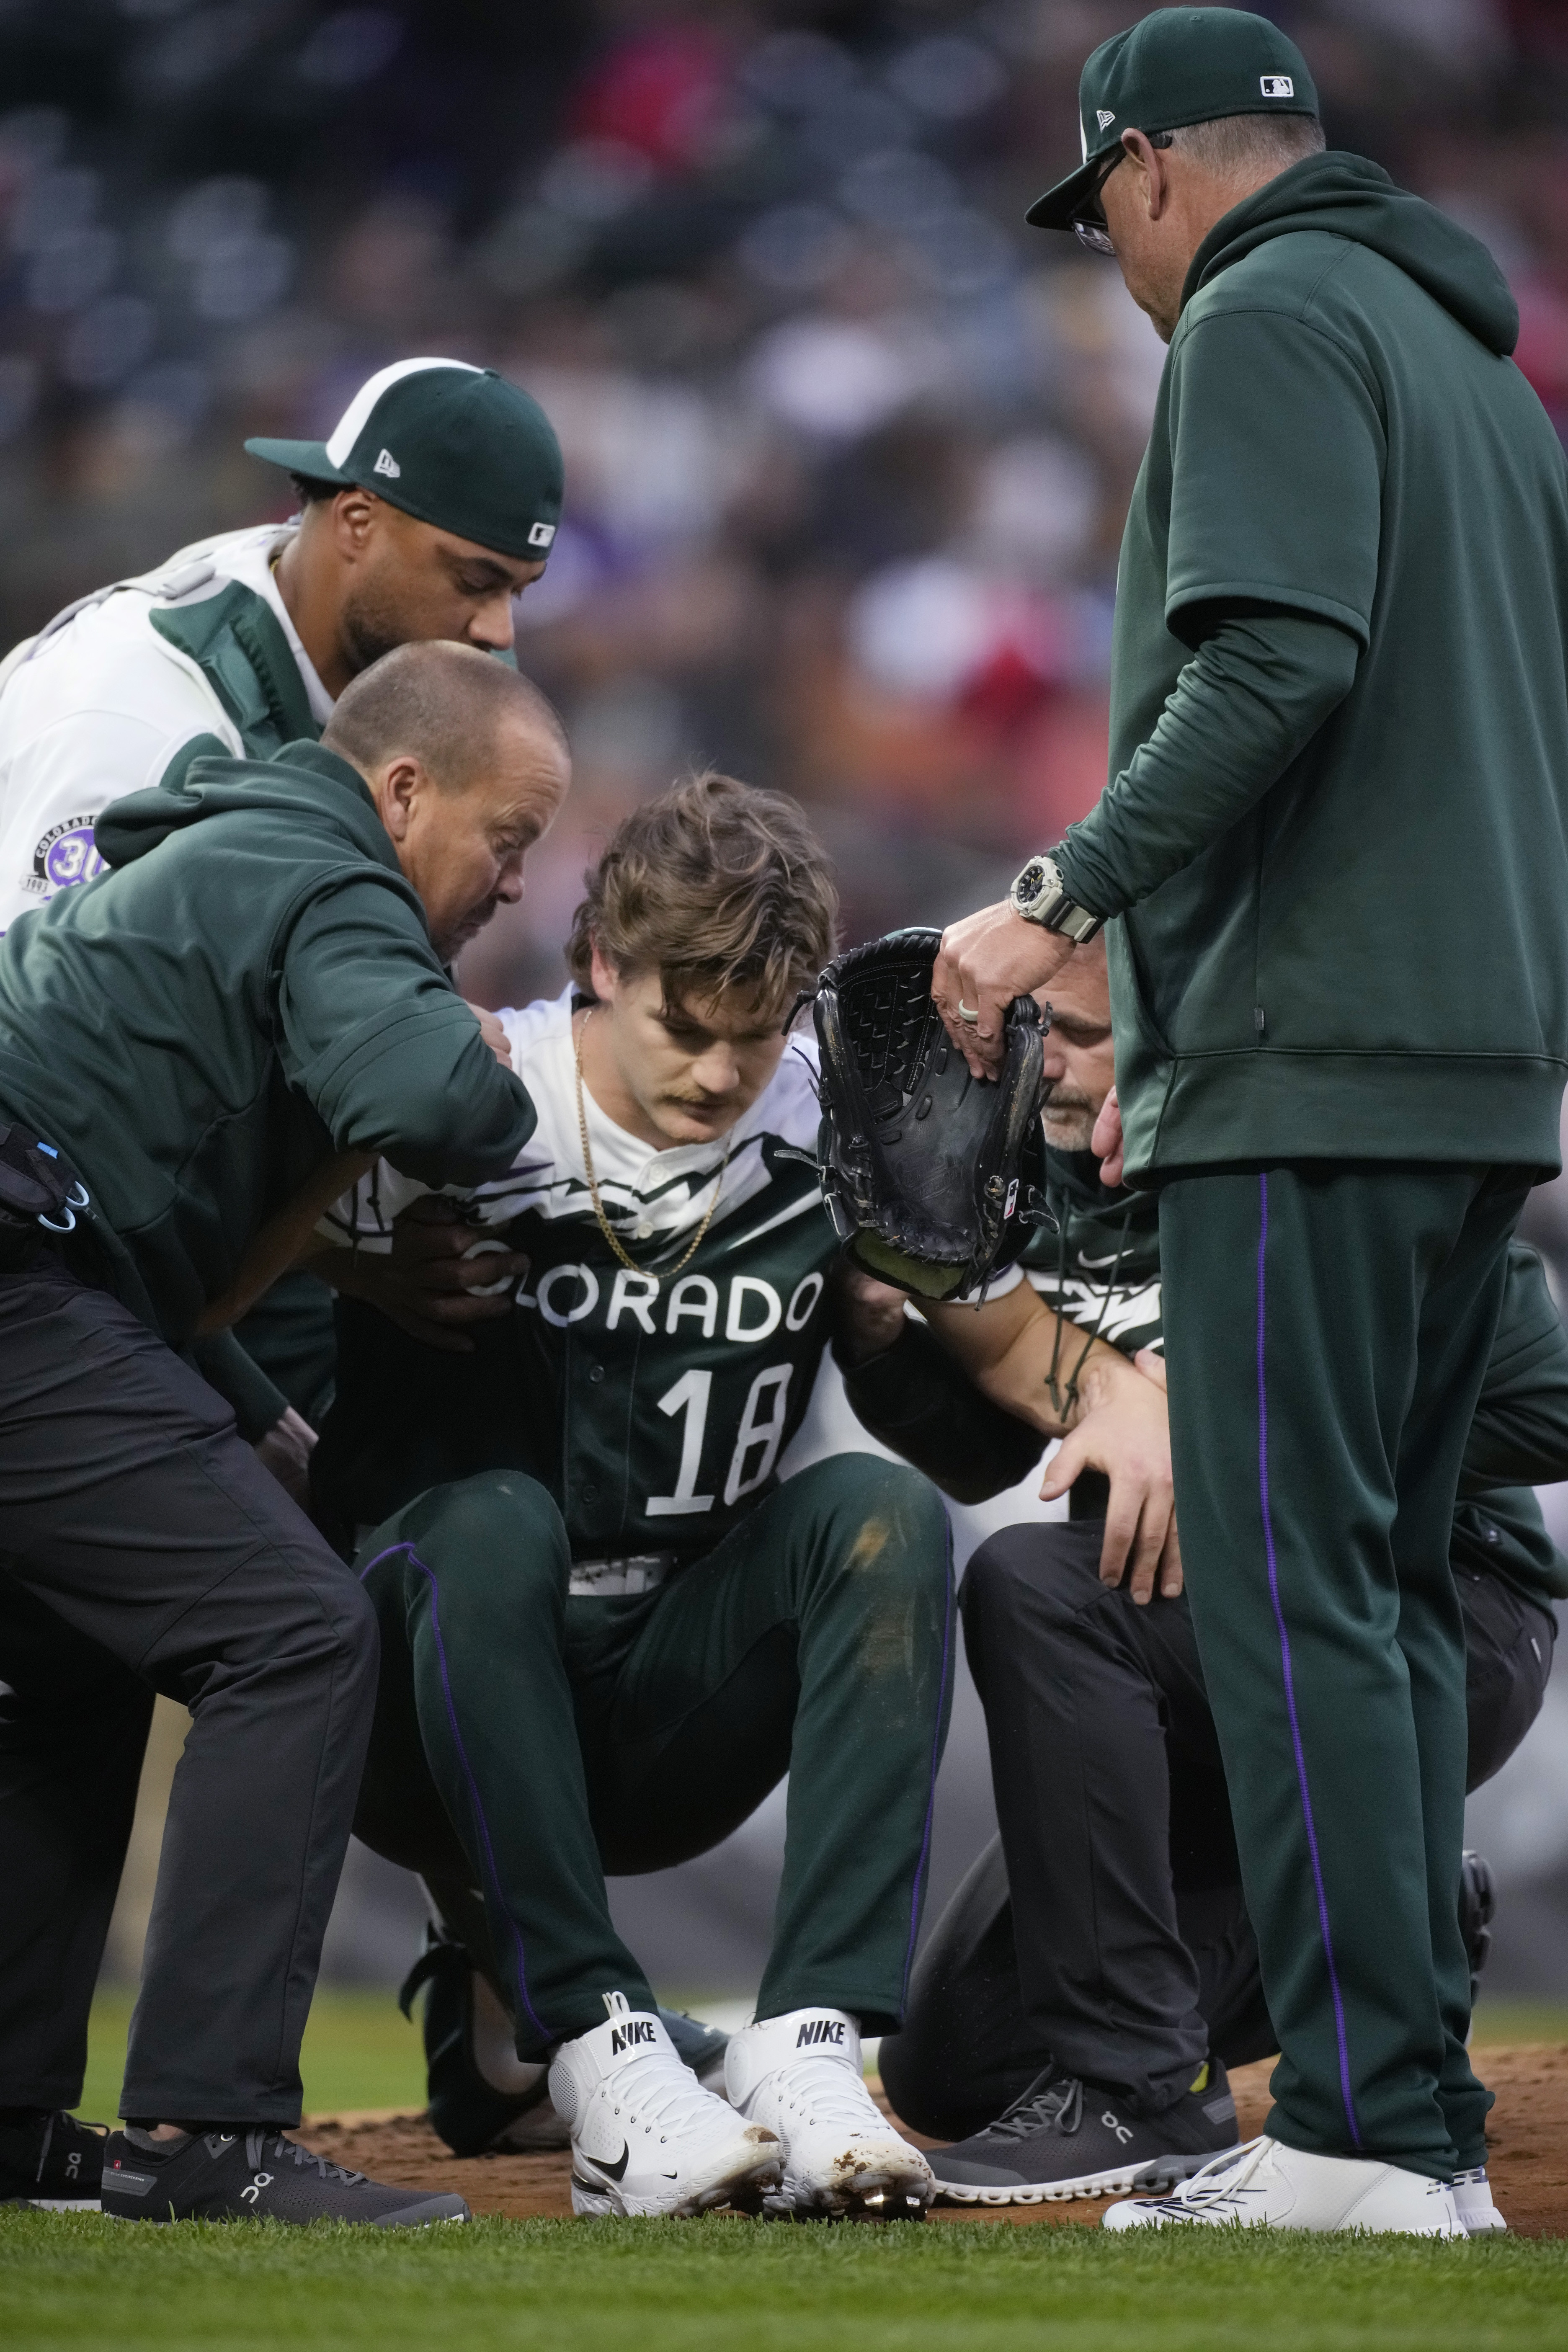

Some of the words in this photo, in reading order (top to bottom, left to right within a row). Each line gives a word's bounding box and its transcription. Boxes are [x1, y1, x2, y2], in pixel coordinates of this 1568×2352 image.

[645, 1362, 794, 1516] 18
[611, 2021, 656, 2056] NIKE
[796, 2020, 846, 2048] NIKE
